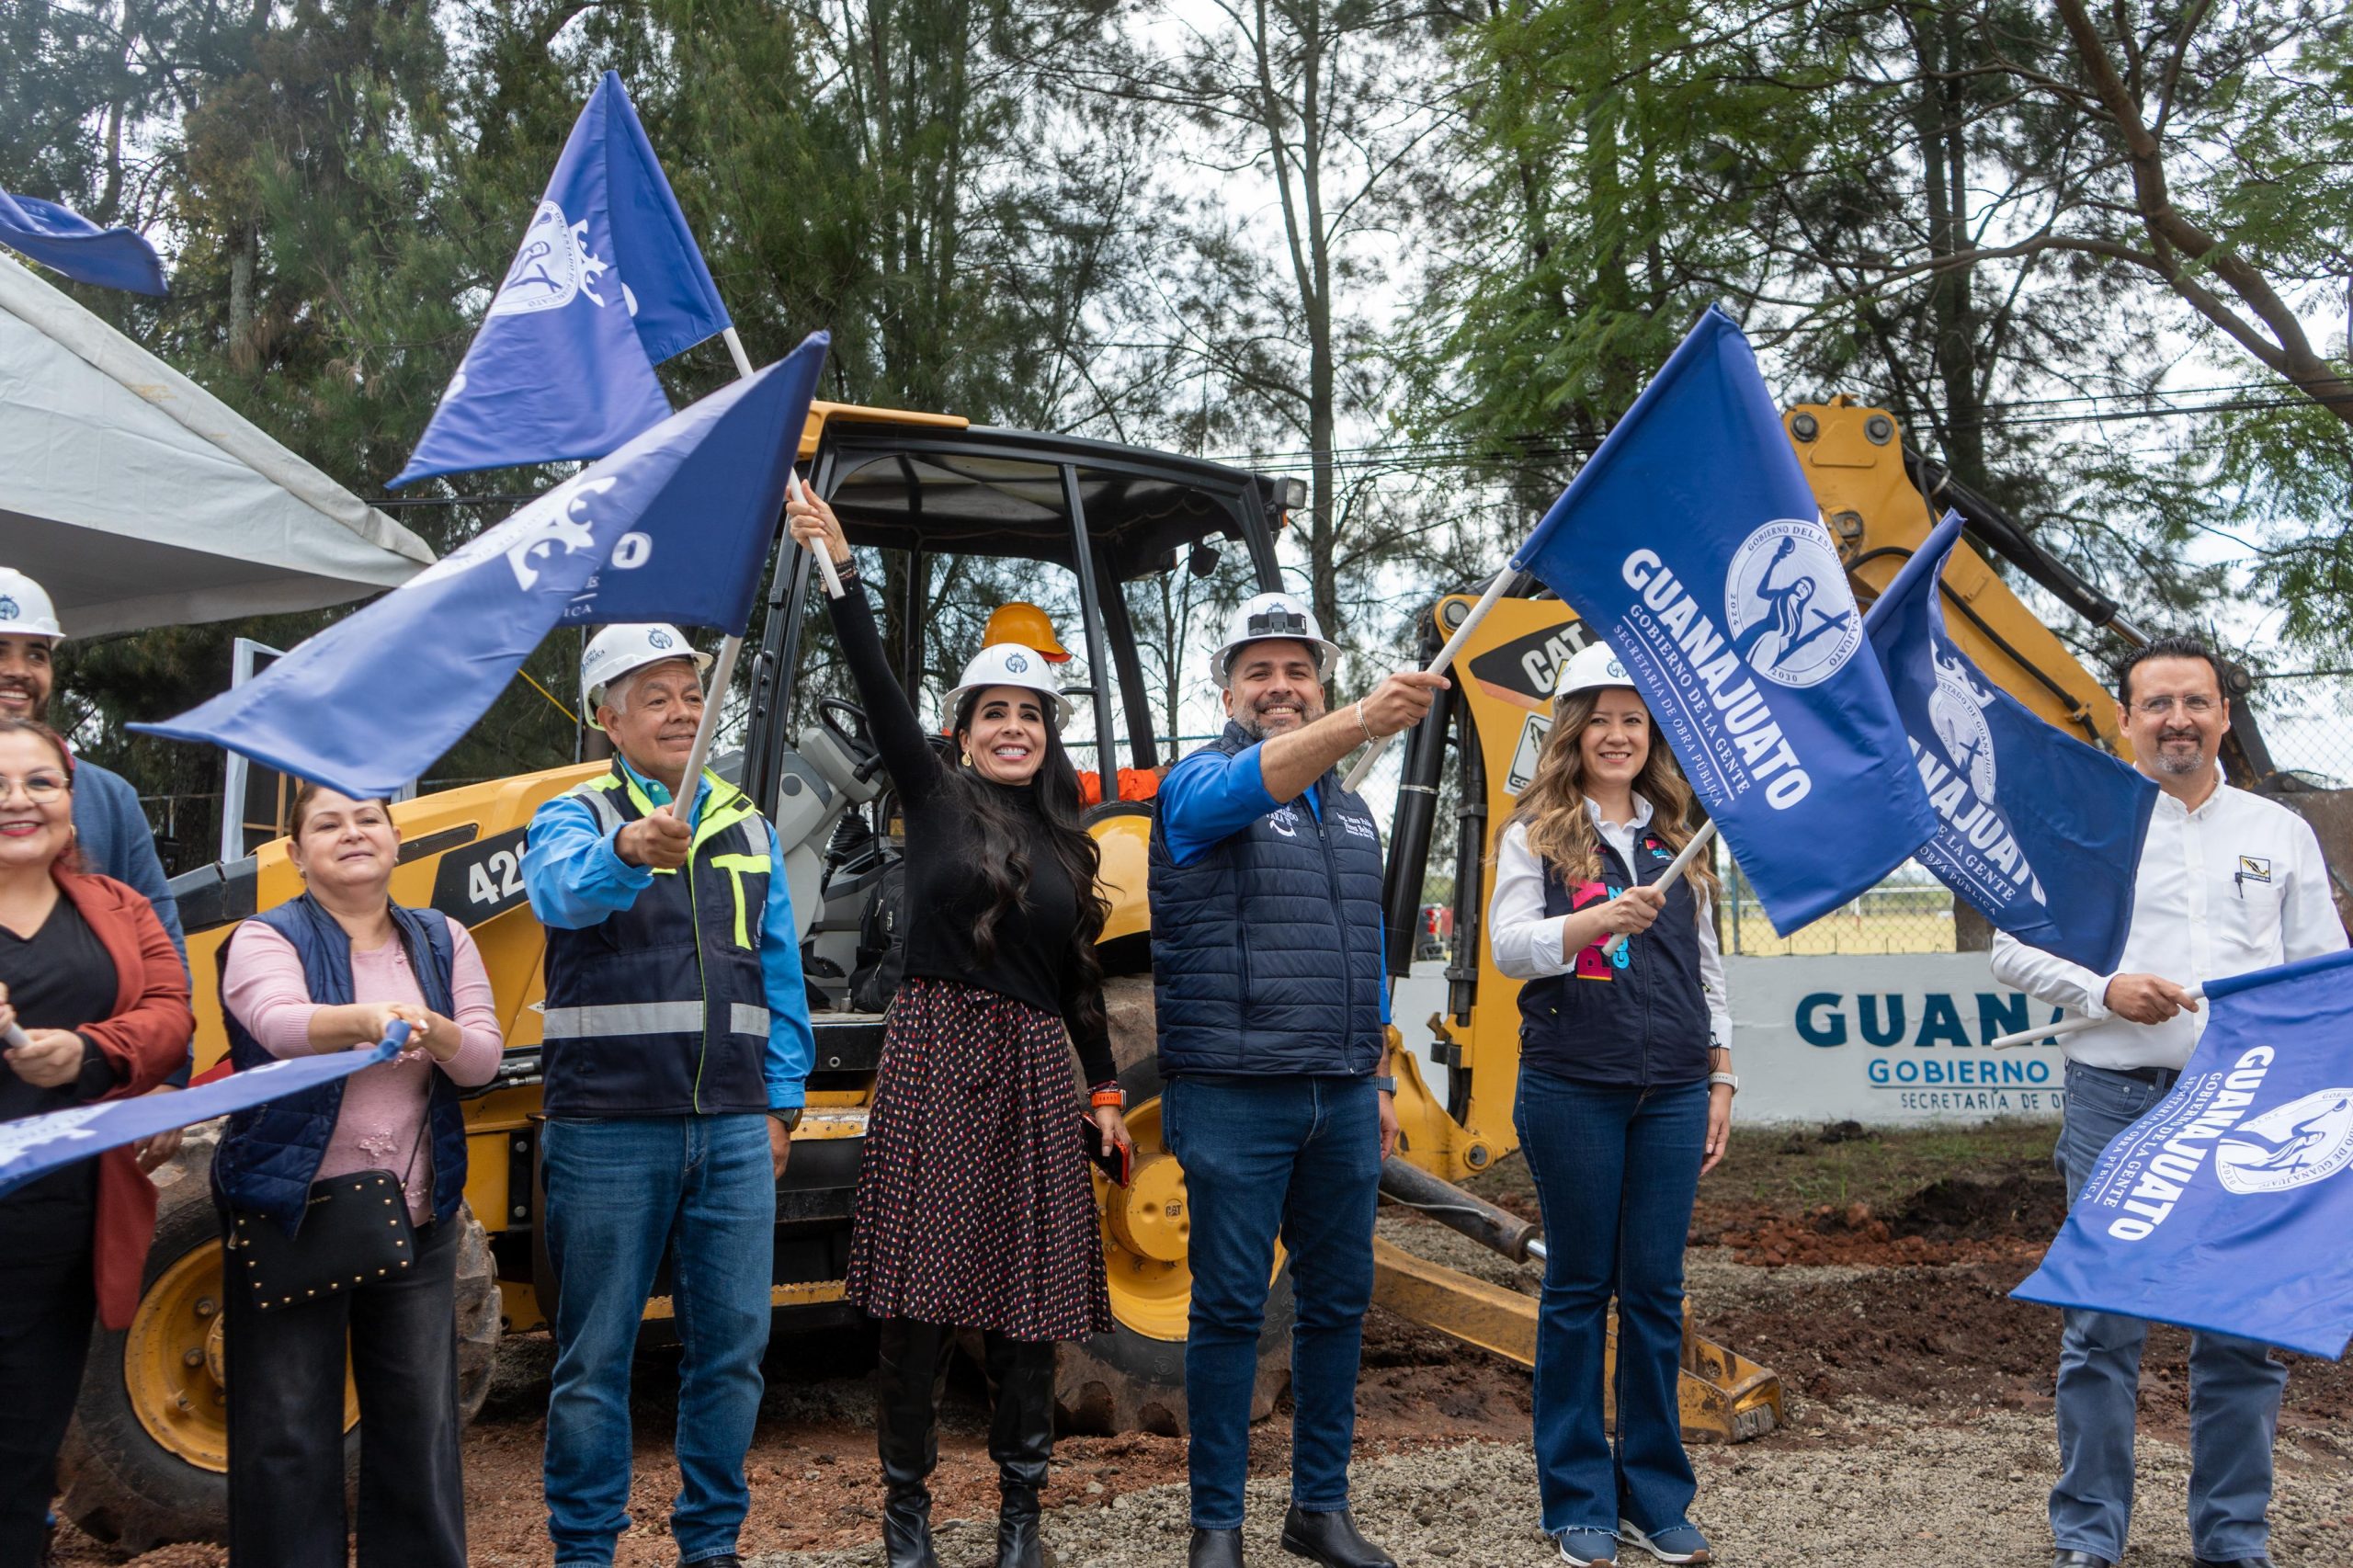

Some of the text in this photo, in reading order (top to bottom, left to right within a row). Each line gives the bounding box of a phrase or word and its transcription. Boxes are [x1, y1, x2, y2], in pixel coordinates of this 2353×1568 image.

[1747, 526, 1789, 551] GOBIERNO
[1792, 526, 1814, 539] DEL
[1521, 622, 1588, 694] CAT
[1621, 549, 1813, 811] GUANAJUATO
[1771, 668, 1798, 683] 2030
[1613, 623, 1724, 808] SECRETARÍA DE OBRA PÚBLICA
[1630, 603, 1751, 795] GOBIERNO DE LA GENTE
[1967, 705, 1977, 719] DE
[469, 840, 526, 905] 42
[1920, 845, 1996, 916] OBRA PÚBLICA
[1946, 838, 1963, 859] LA
[1965, 854, 2017, 902] GENTE
[1868, 1058, 2051, 1084] GOBIERNO
[1901, 1087, 2009, 1109] SECRETARÍA
[2022, 1093, 2040, 1109] DE
[2102, 1072, 2223, 1209] GOBIERNO DE LA GENTE
[2108, 1045, 2276, 1242] GUANAJUATO
[2113, 1131, 2140, 1153] OBRA
[2222, 1164, 2236, 1186] 2030
[2258, 1147, 2347, 1189] DE GUANAJUA
[1165, 1204, 1182, 1219] CAT
